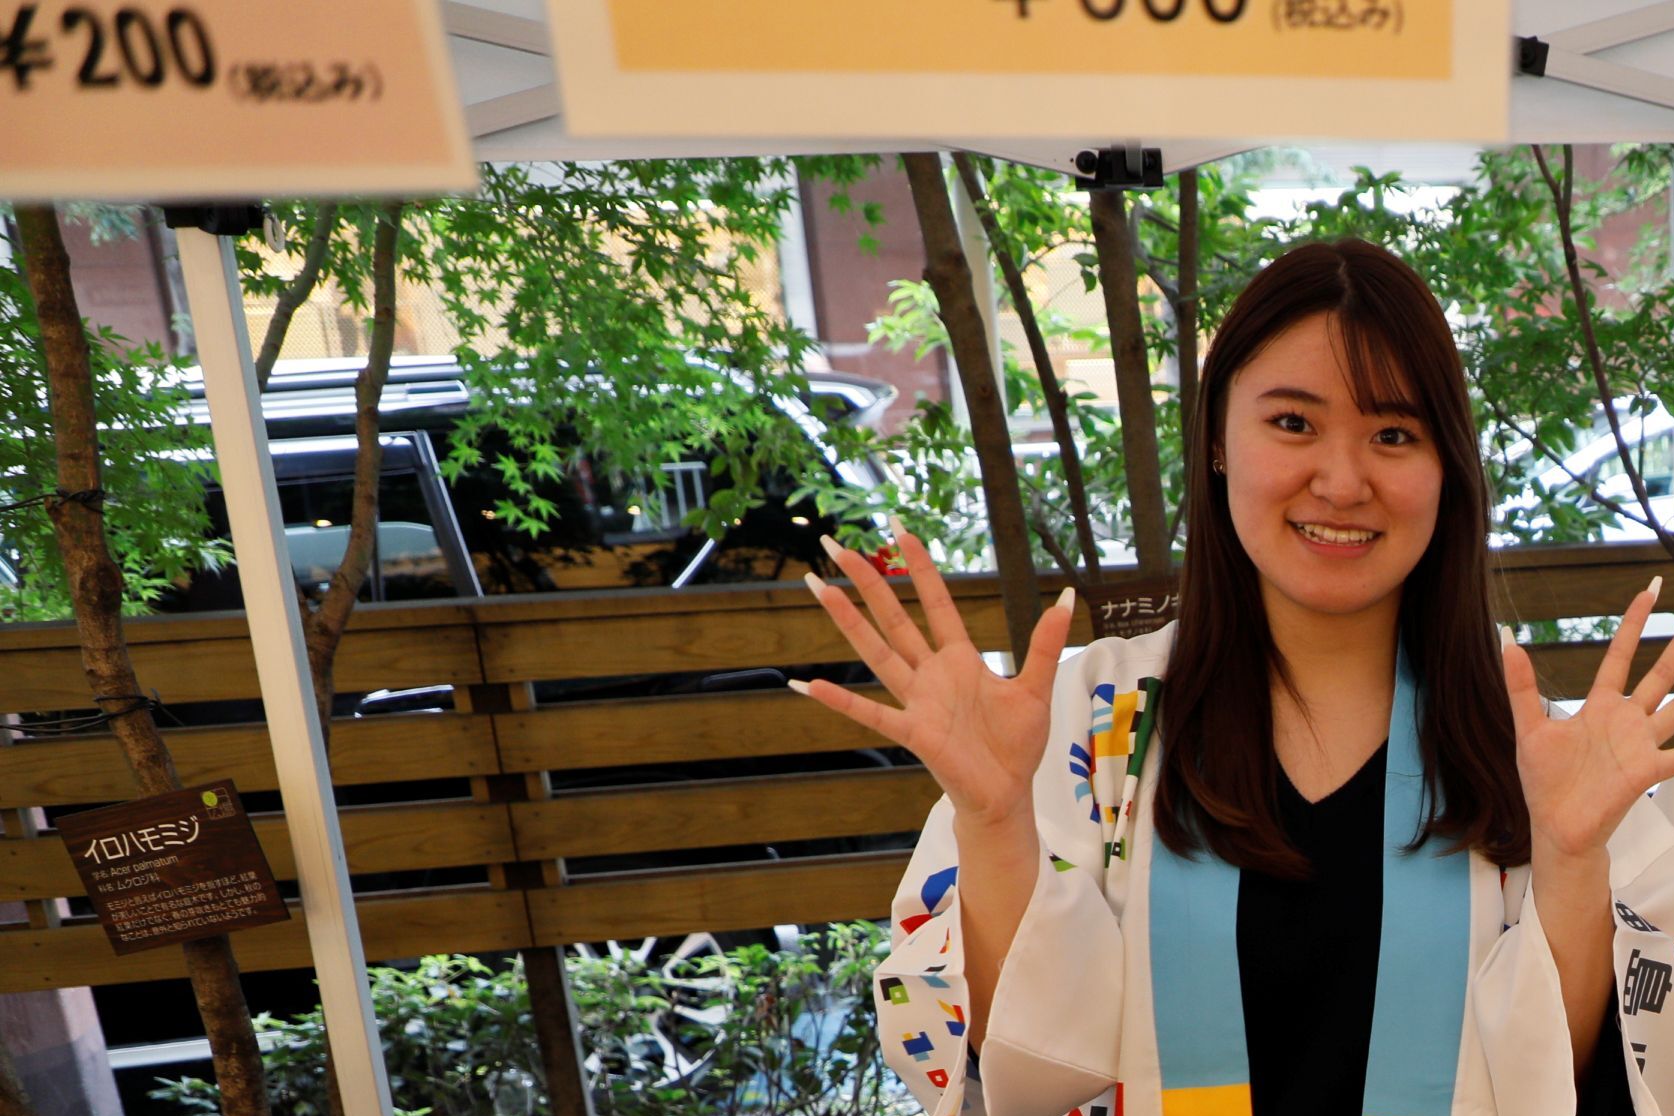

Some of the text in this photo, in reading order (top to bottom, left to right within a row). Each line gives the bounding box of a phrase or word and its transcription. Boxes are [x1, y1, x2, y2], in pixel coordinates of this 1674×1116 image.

[0, 2, 217, 91] ¥200
[84, 815, 199, 865] イロハモミジ
[110, 865, 131, 877] Acer
[133, 854, 179, 874] palmatum
